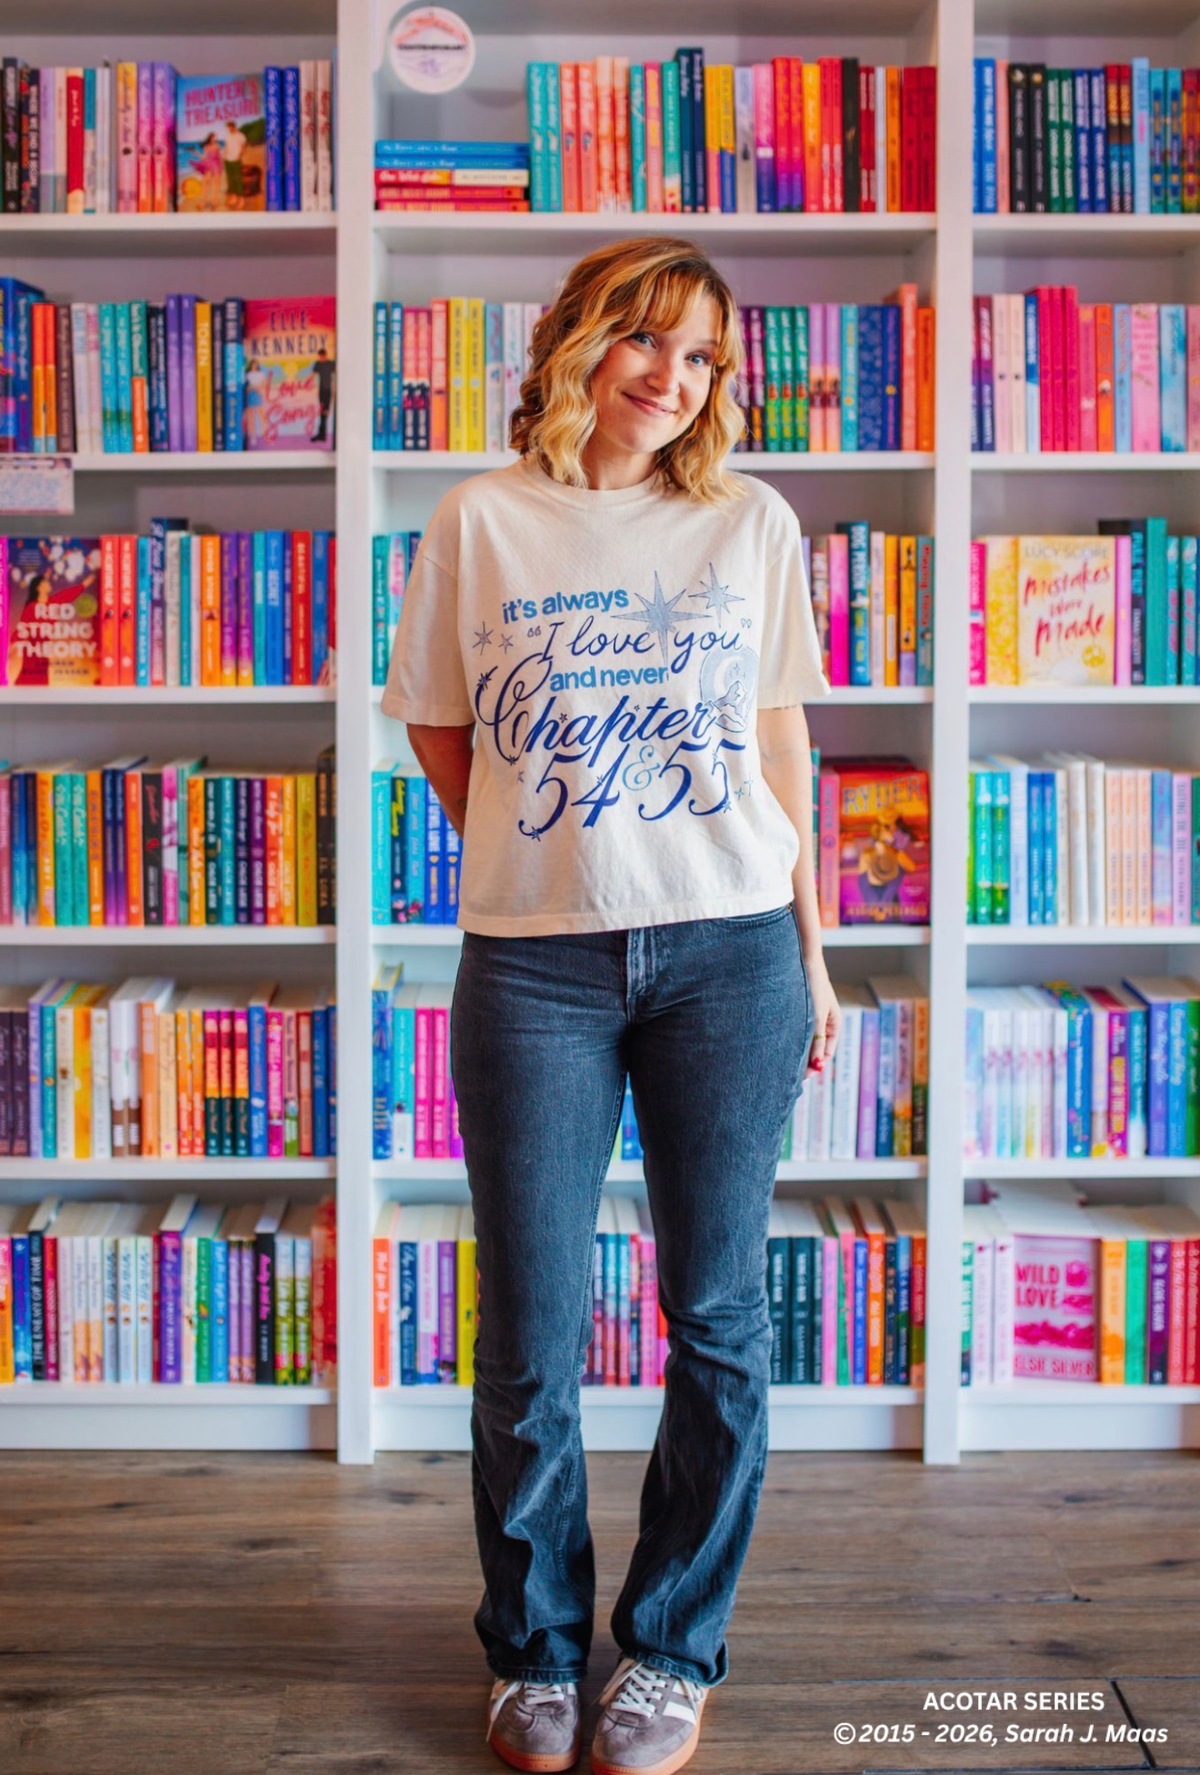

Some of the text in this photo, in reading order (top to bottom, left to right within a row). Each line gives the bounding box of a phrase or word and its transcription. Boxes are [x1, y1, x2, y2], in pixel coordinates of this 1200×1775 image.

[270, 310, 309, 332] ELLE
[251, 333, 328, 357] KENNEDY
[34, 602, 76, 620] RED
[502, 589, 630, 625] it's always
[16, 621, 94, 640] STRING
[566, 615, 656, 657] love
[1034, 603, 1106, 657] made
[15, 640, 97, 659] THEORY
[549, 665, 669, 692] and never
[475, 652, 718, 768] Chapter
[518, 743, 631, 837] 54
[622, 744, 661, 791] &
[842, 775, 922, 815] RYDER
[1015, 1262, 1060, 1285] WILD
[1015, 1285, 1059, 1310] LOVE
[1052, 1357, 1096, 1377] SILVER
